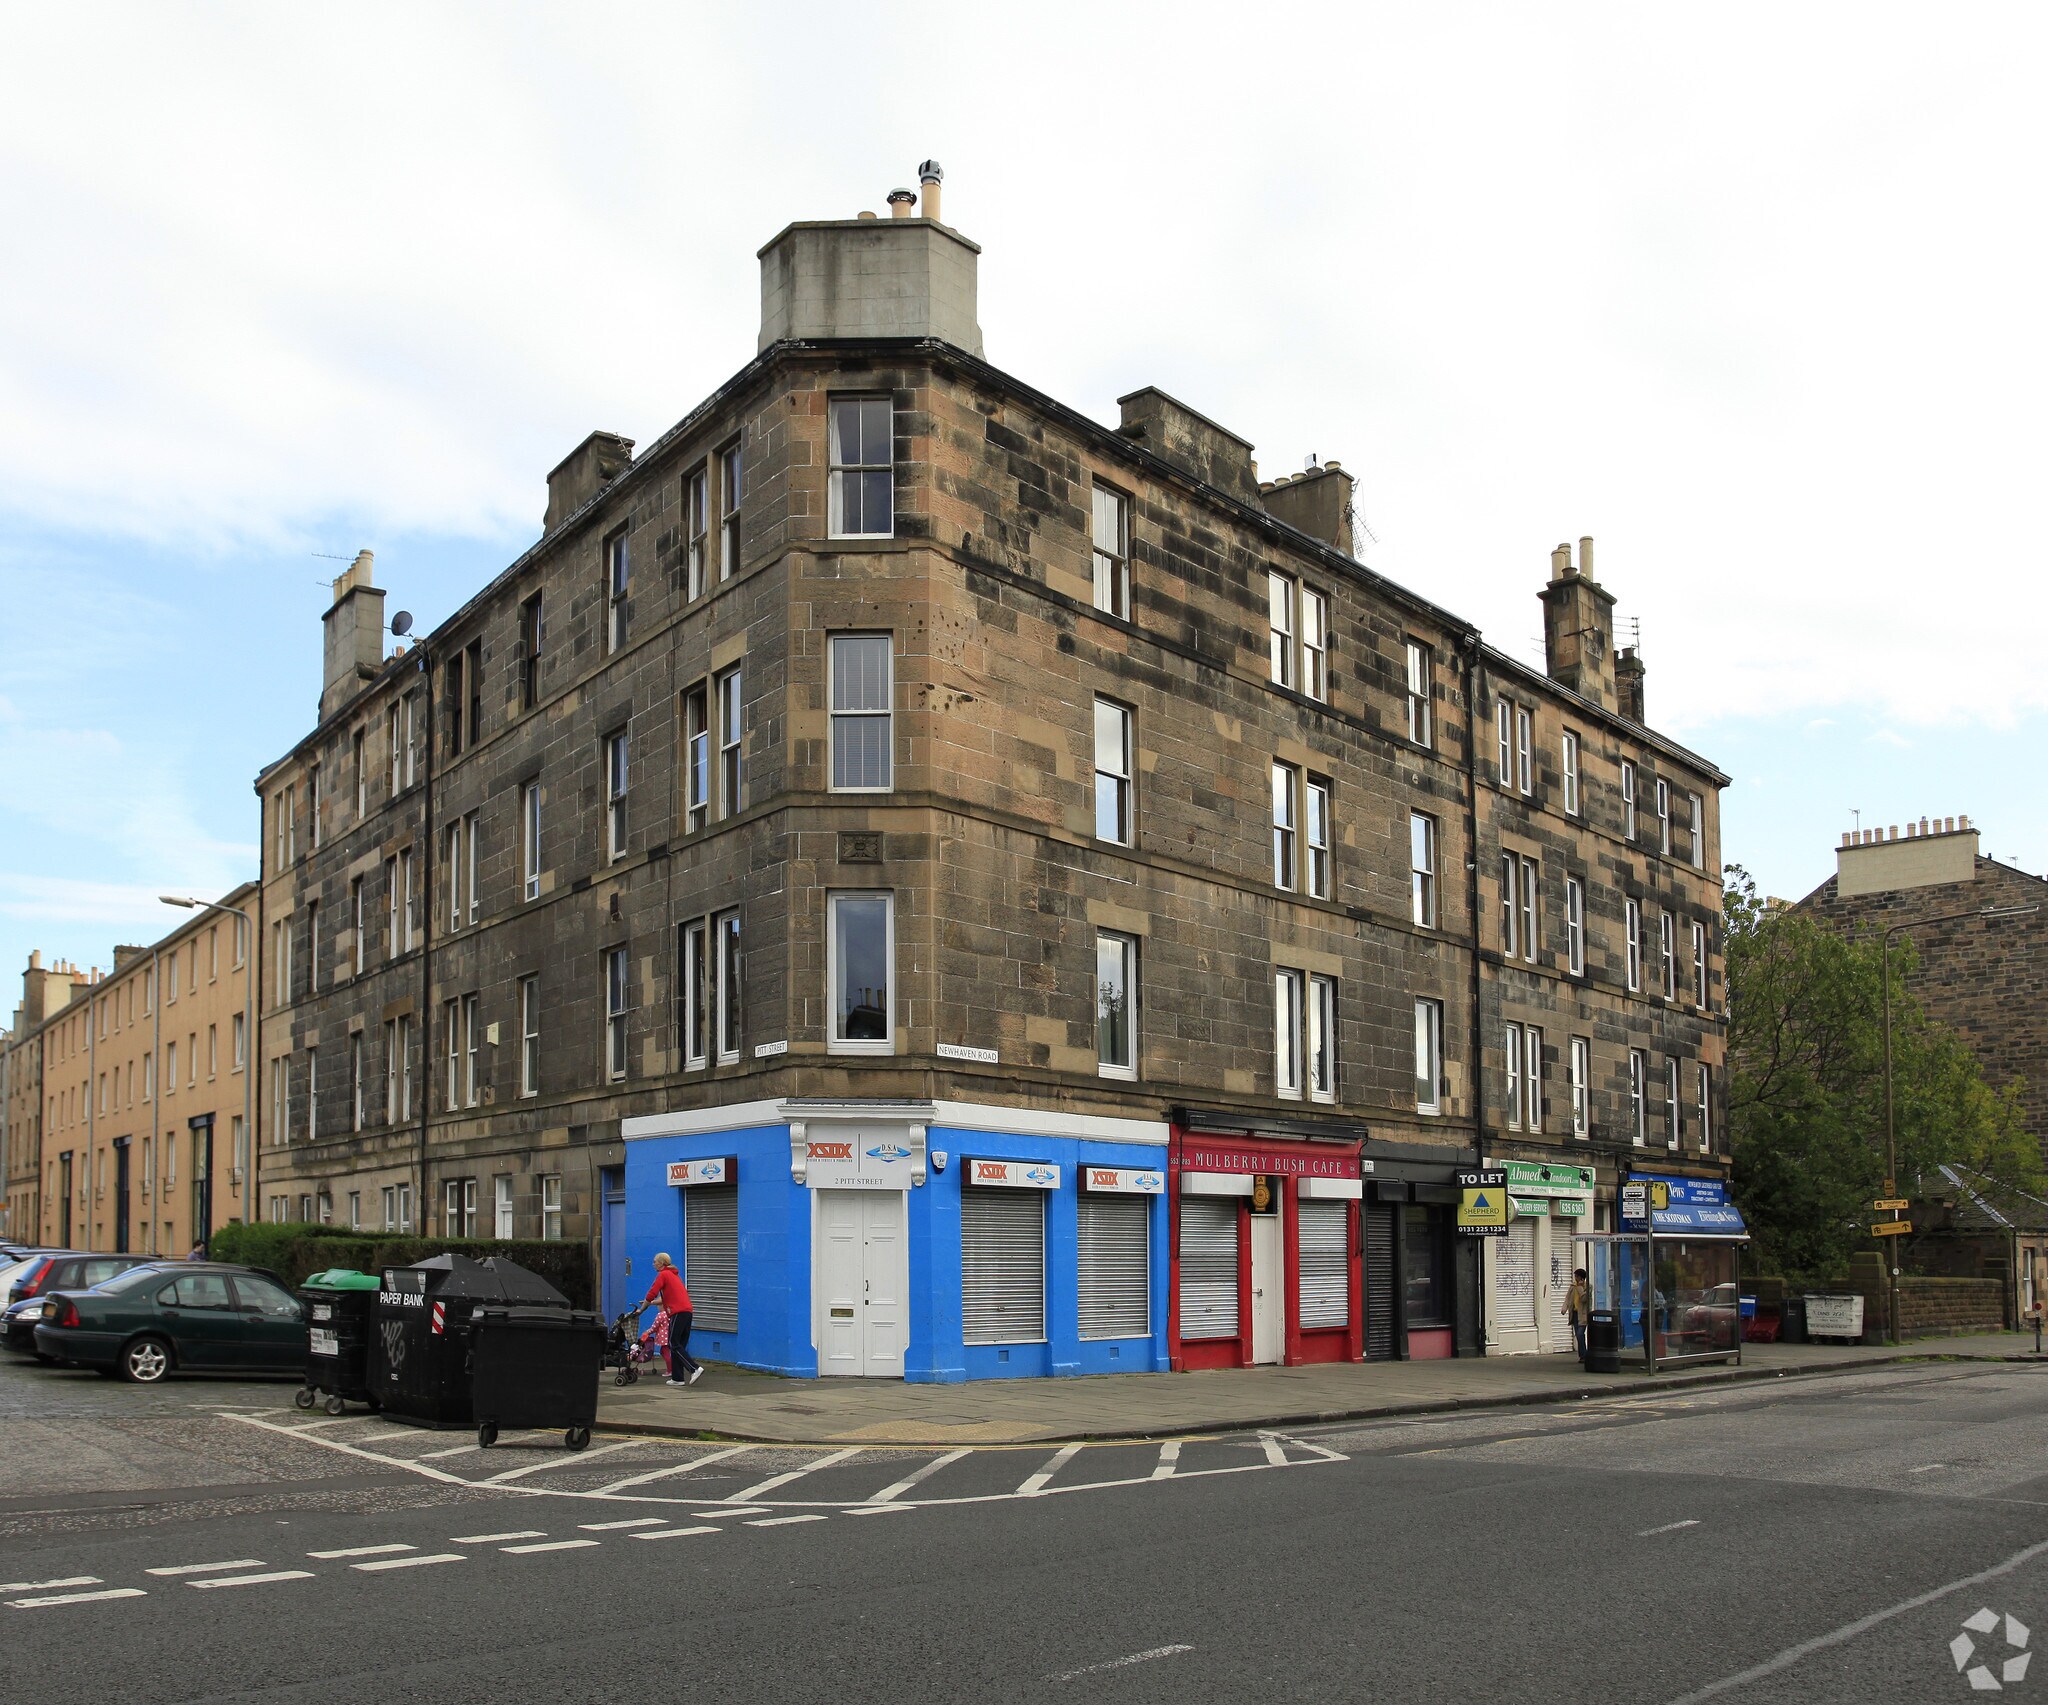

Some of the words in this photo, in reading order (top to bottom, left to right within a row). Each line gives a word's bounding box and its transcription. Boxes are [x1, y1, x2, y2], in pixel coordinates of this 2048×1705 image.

[757, 1045, 767, 1055] PITT
[769, 1042, 786, 1053] STREET
[938, 1045, 976, 1058] NEWHAVEN
[978, 1051, 997, 1061] ROAD
[1195, 1153, 1268, 1170] MULBERRY
[1275, 1157, 1305, 1172] BUSH
[1459, 1174, 1478, 1184] TO
[1480, 1173, 1504, 1183] LET
[1666, 1181, 1685, 1199] News
[1463, 1207, 1500, 1215] SHEPHERD
[1653, 1212, 1666, 1222] THE
[1665, 1213, 1693, 1223] SCOTSMAN
[380, 1292, 401, 1305] PAPER
[403, 1293, 424, 1307] BANK
